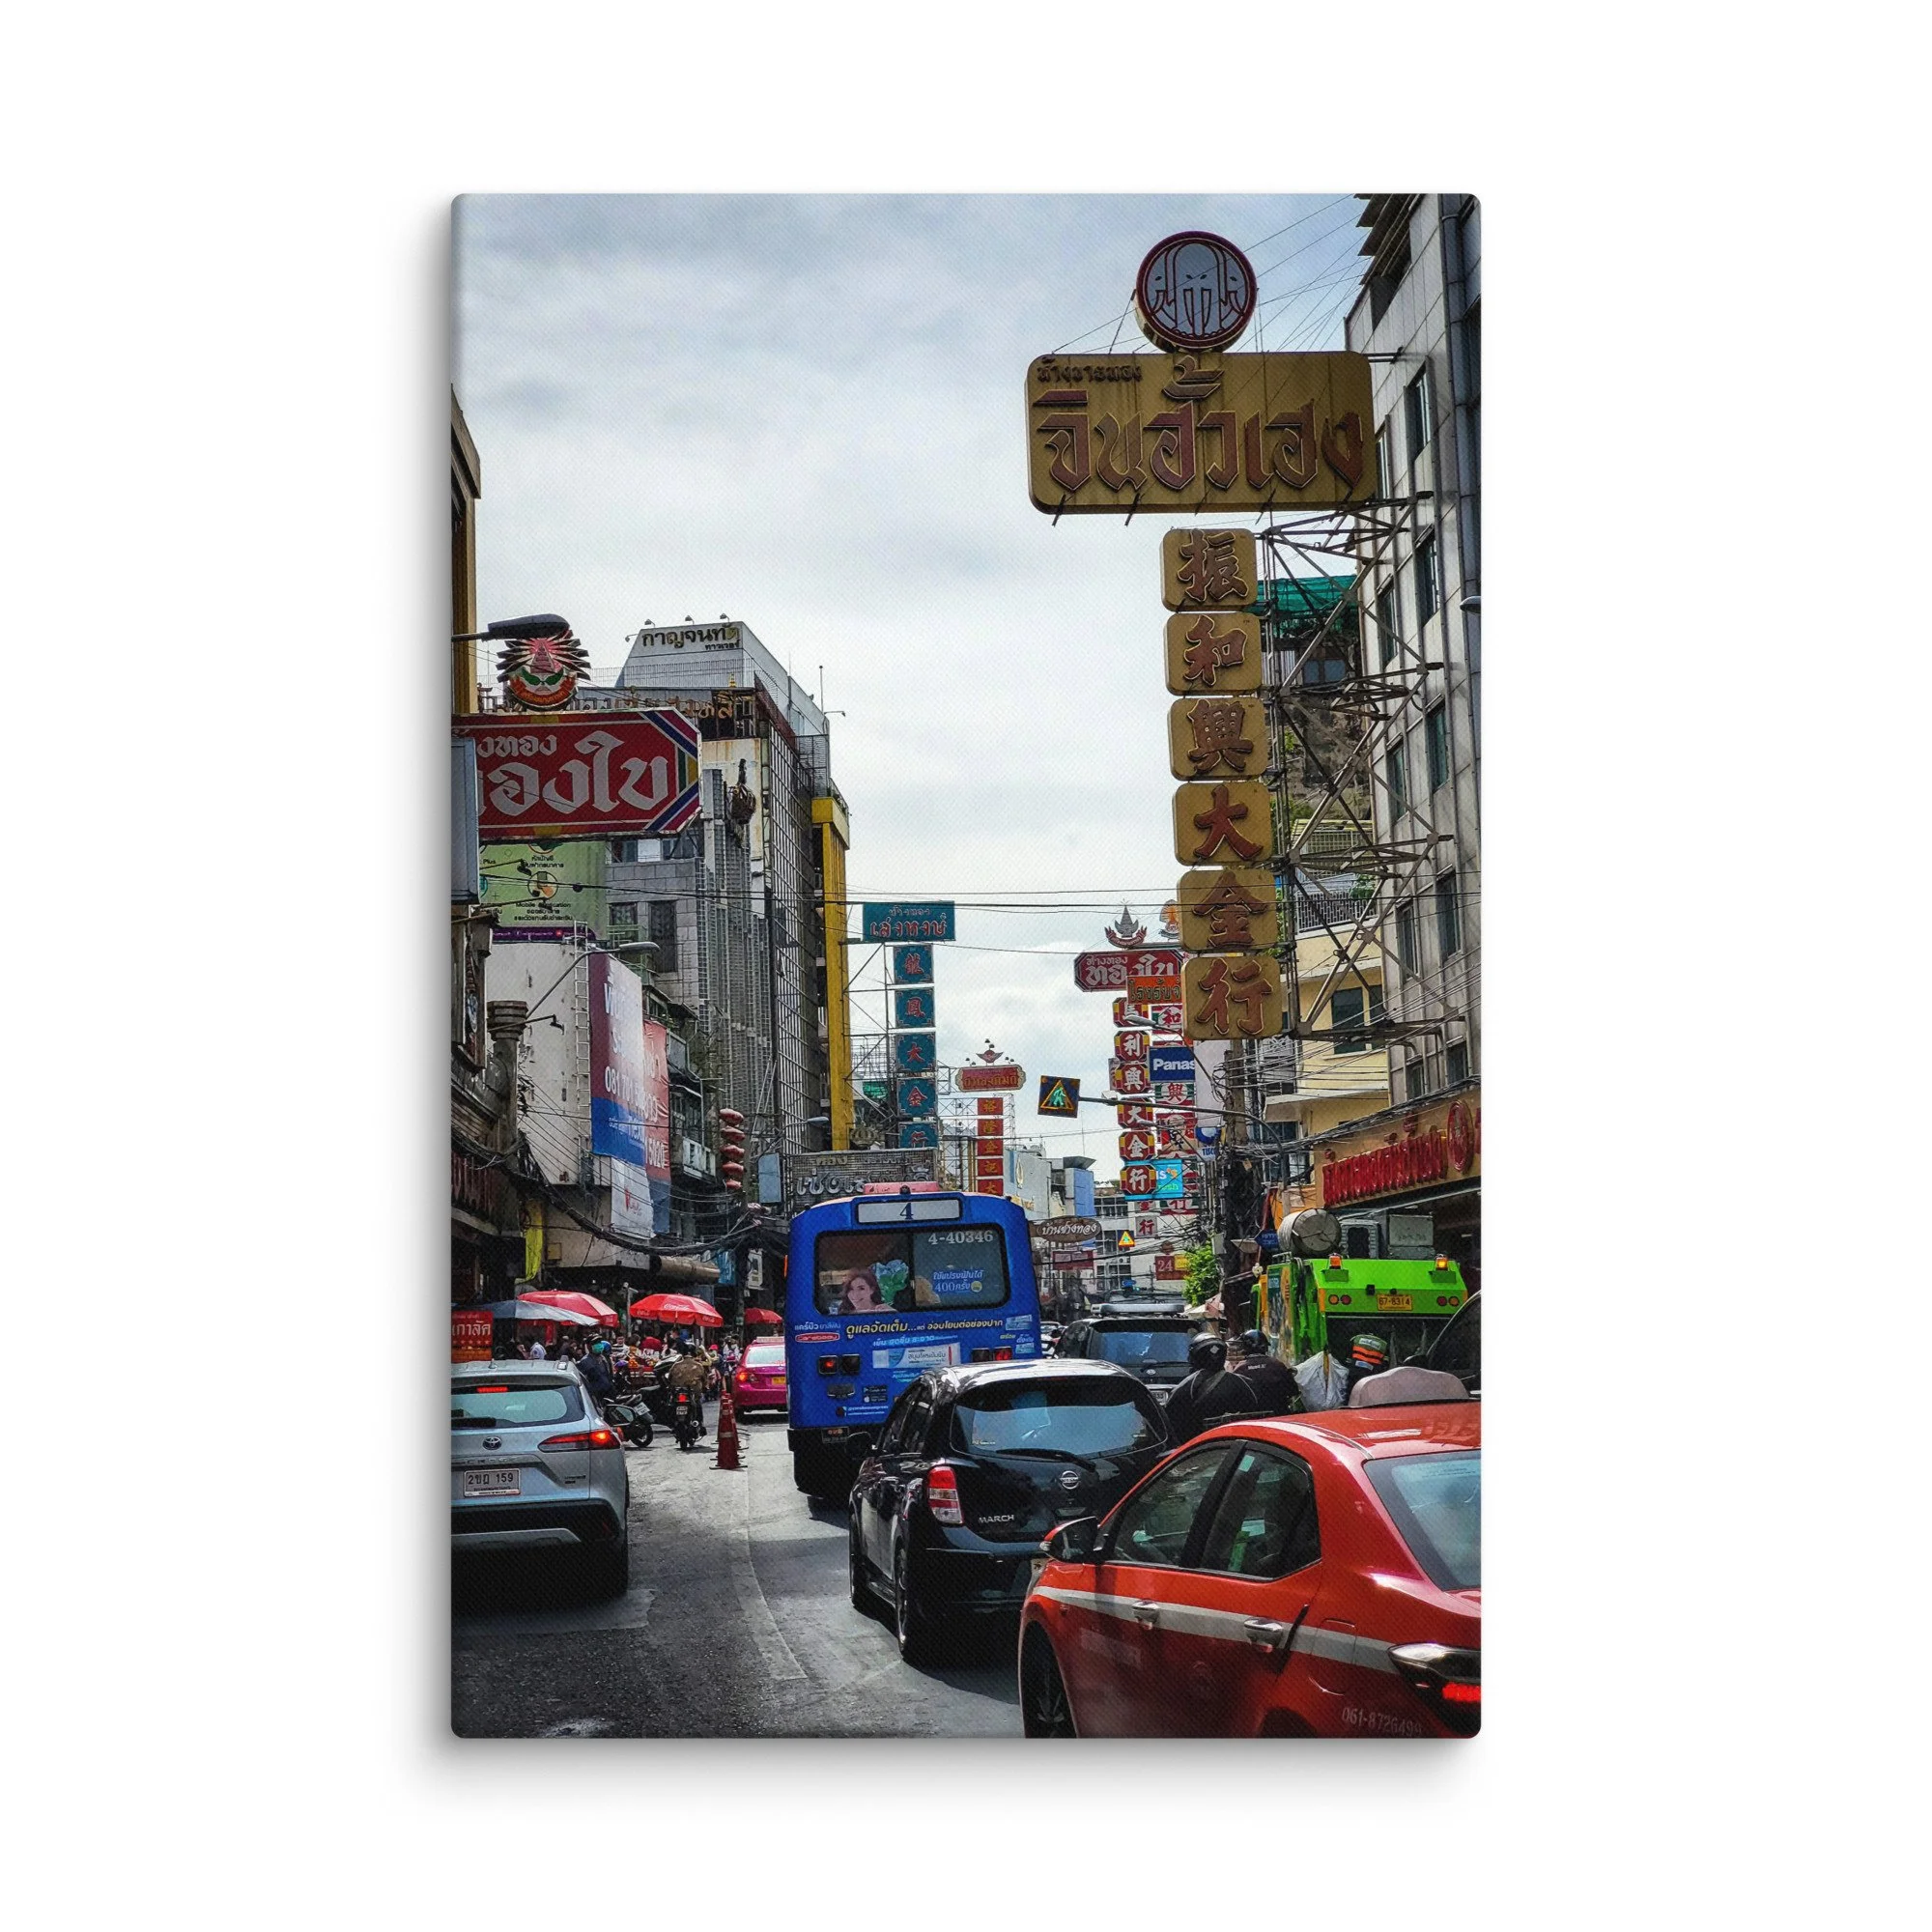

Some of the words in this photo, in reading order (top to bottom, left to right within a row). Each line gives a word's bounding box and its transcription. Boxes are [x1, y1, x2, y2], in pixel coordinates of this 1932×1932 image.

[478, 730, 668, 816] องใบ
[1178, 529, 1274, 1037] 振和興大金行
[899, 1203, 914, 1221] 4
[927, 1230, 995, 1245] 4-40346
[1157, 1260, 1174, 1272] 24
[496, 1472, 514, 1484] 159
[978, 1514, 1015, 1524] MARCH
